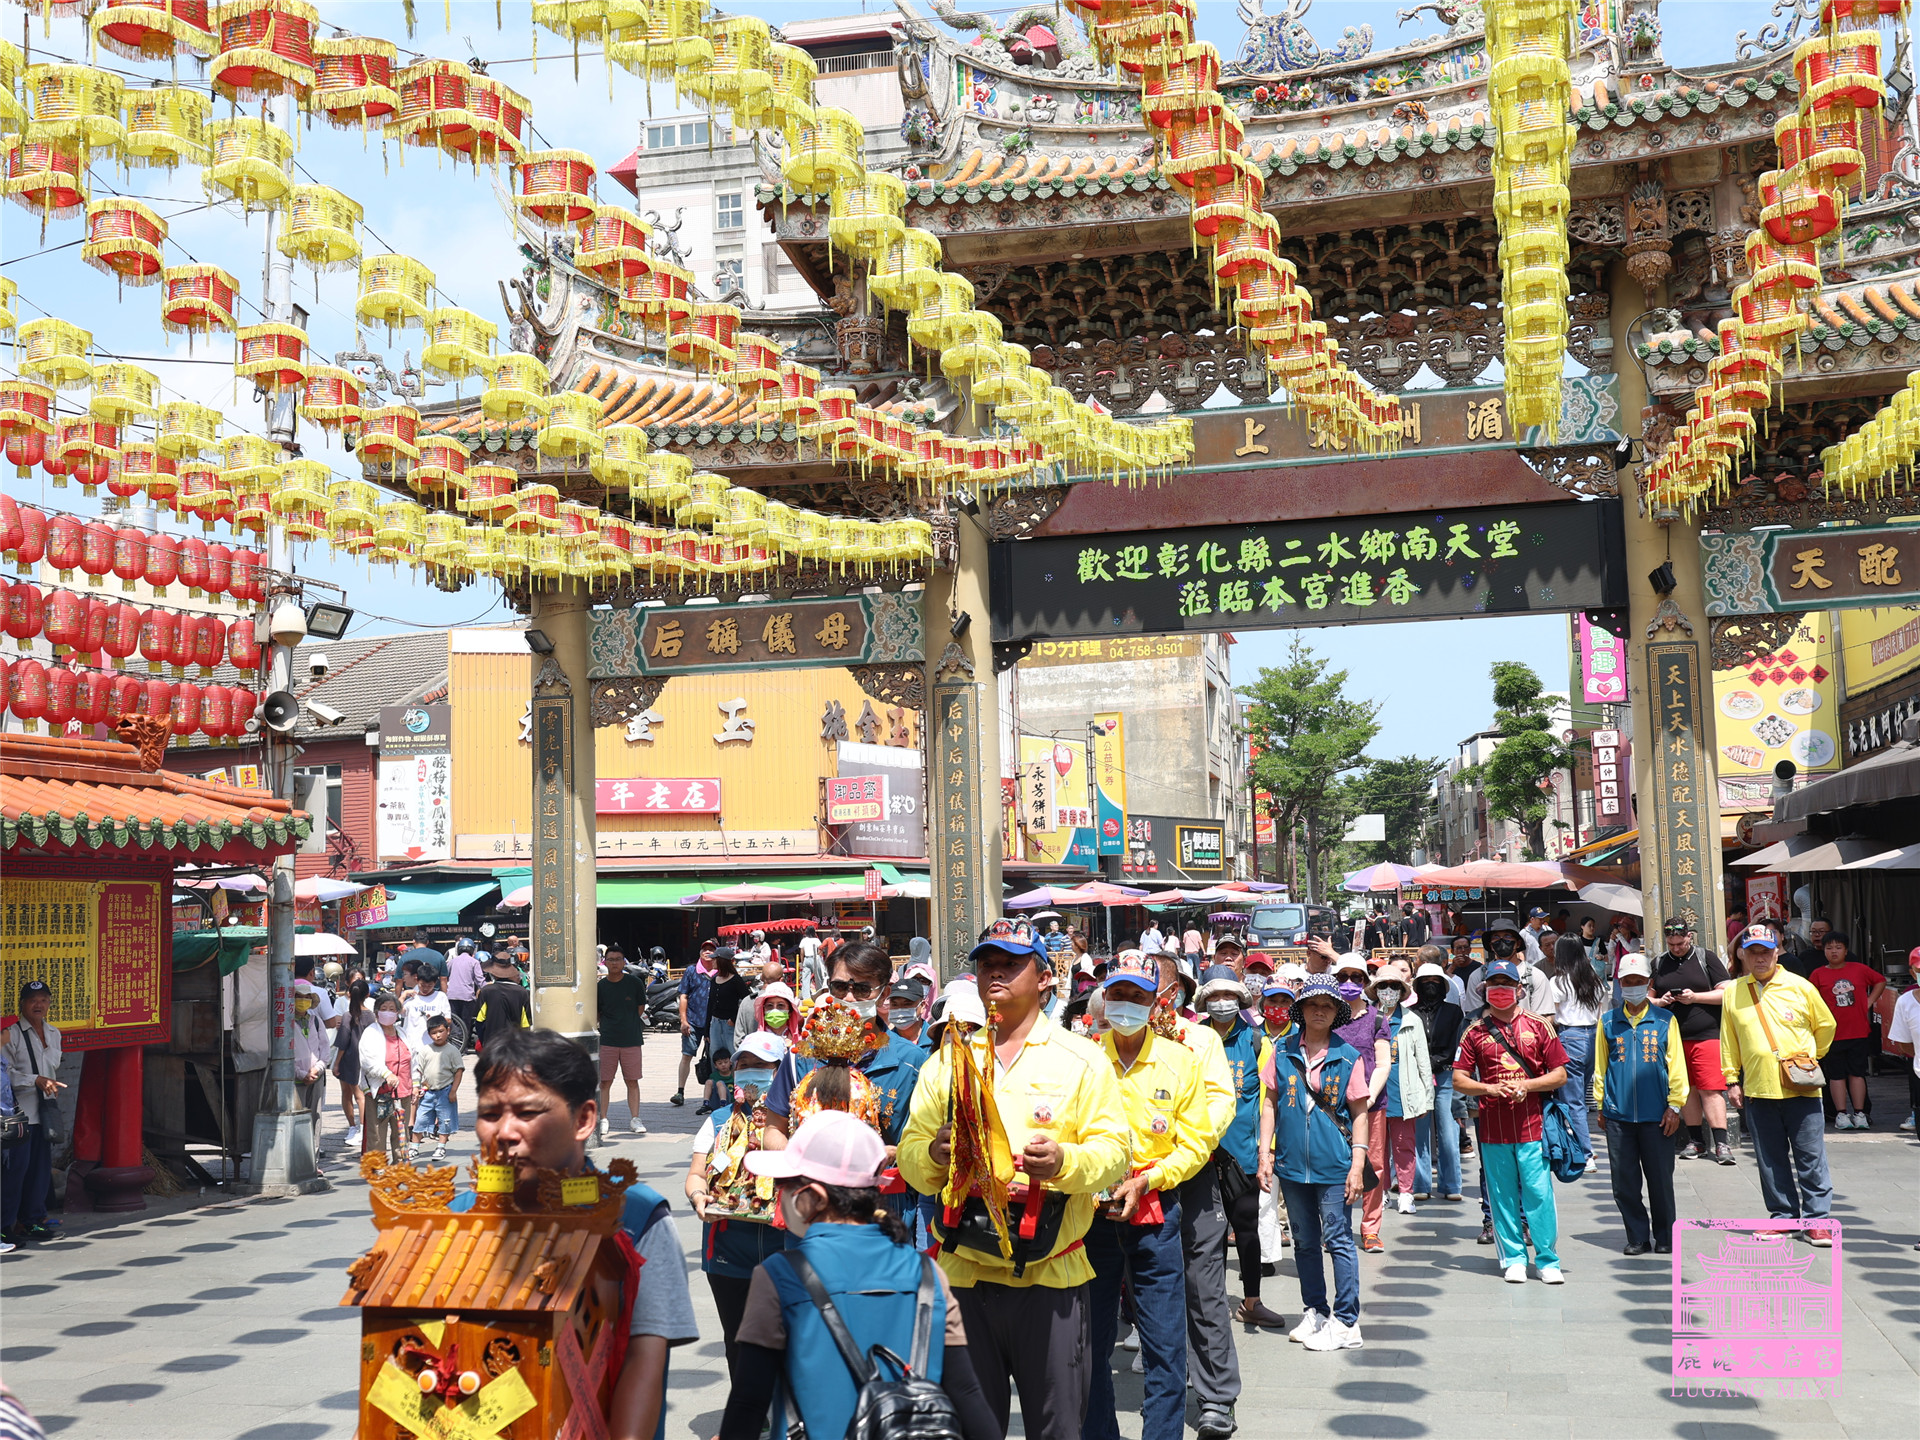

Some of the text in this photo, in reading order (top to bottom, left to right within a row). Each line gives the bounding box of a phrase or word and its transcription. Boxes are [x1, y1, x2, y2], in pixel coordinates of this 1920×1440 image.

[1077, 520, 1522, 584] 歡迎彰化縣二水鄉南天堂
[1109, 643, 1183, 659] 04-758-9501
[432, 756, 447, 797] 酸梅冰
[1103, 741, 1114, 786] 公益彩券
[596, 781, 706, 810] 年老店
[1426, 888, 1482, 902] 外帶免等
